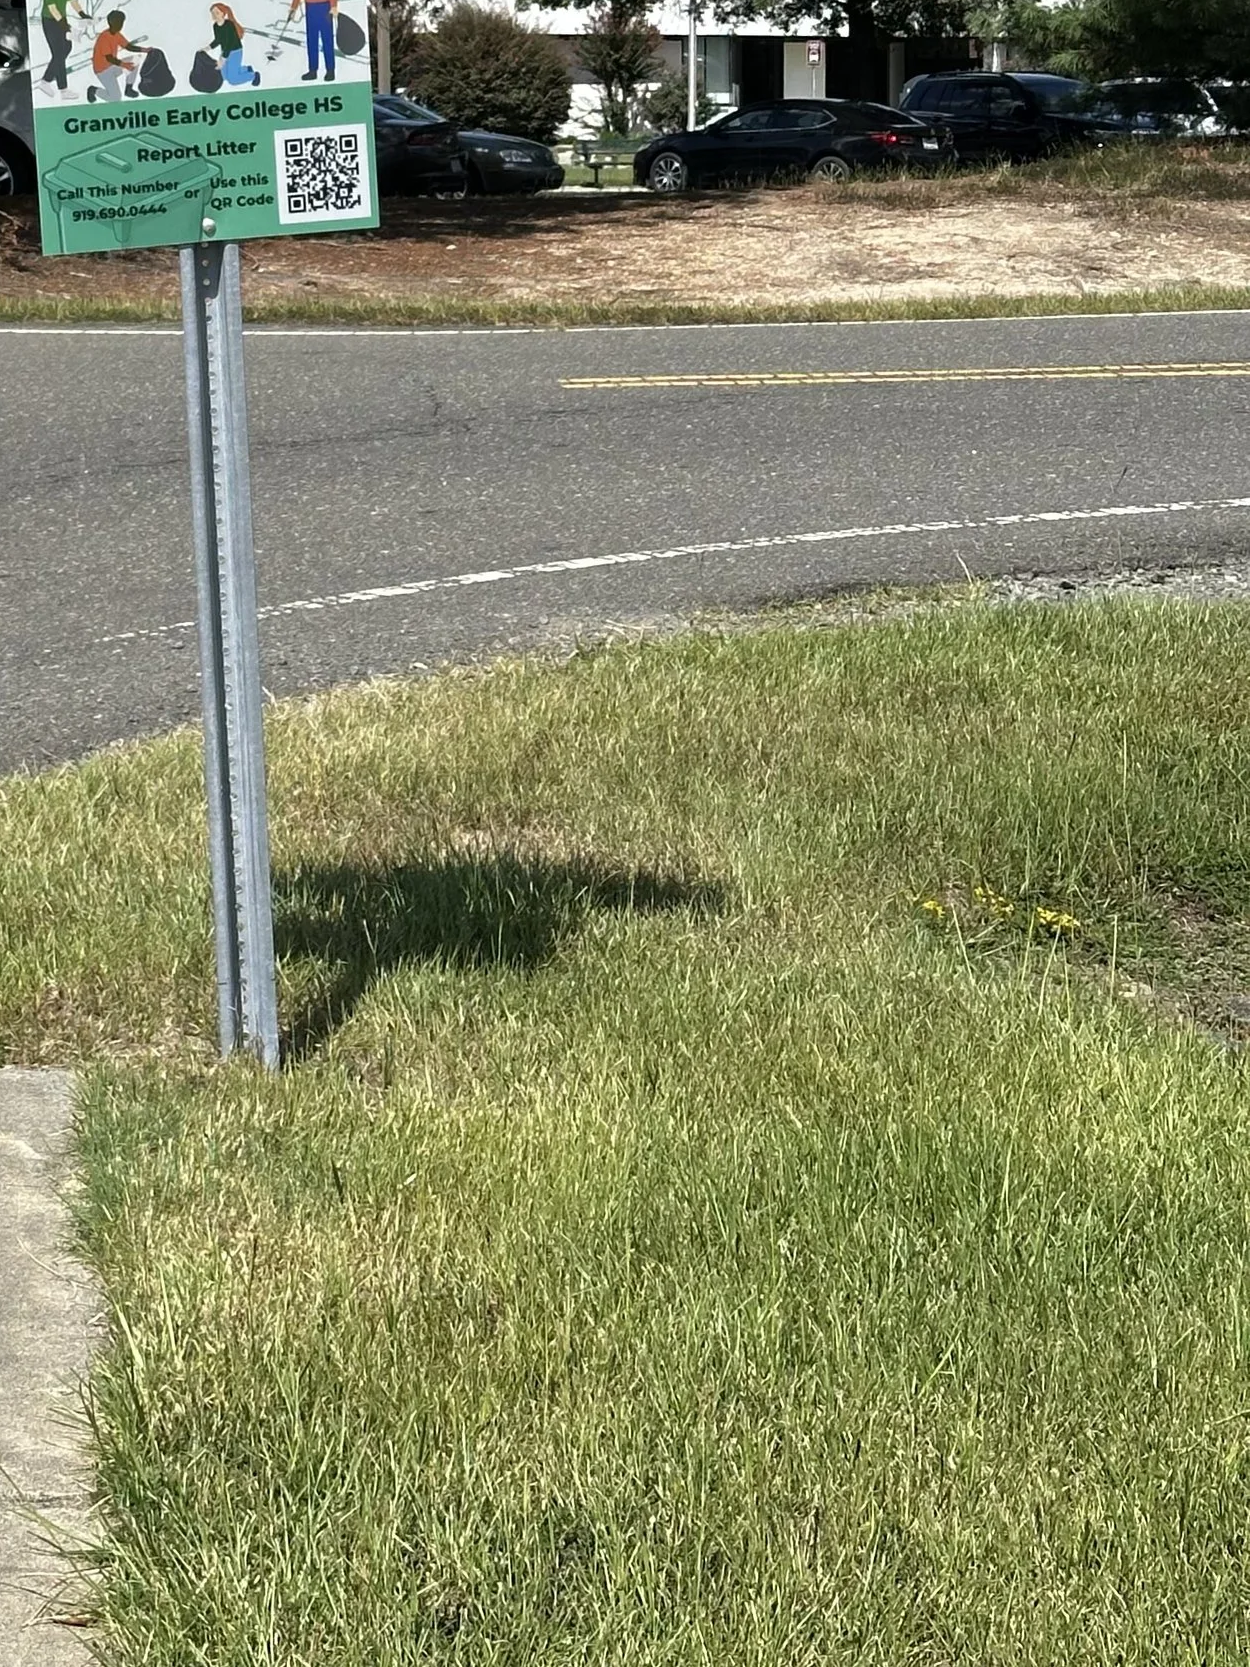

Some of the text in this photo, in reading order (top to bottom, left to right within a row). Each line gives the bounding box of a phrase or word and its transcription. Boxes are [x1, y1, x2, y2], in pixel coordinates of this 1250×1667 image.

[64, 96, 343, 134] Granville Early College HS
[137, 140, 257, 163] Report Litter
[57, 180, 180, 201] Call This Number
[210, 173, 269, 189] Use this
[184, 189, 200, 199] or
[211, 193, 274, 210] QR Code
[72, 203, 167, 222] 919.690.0444
